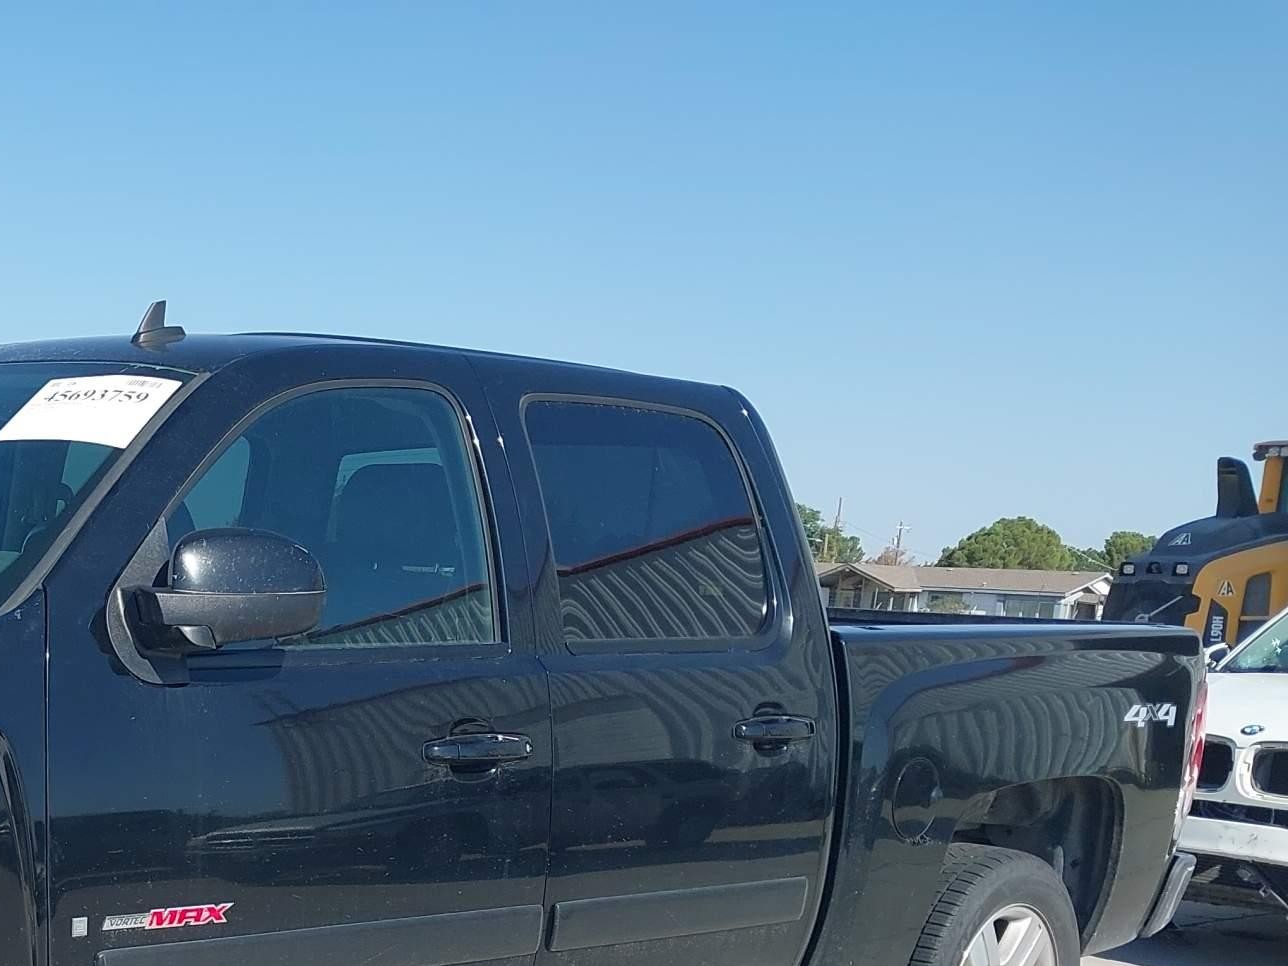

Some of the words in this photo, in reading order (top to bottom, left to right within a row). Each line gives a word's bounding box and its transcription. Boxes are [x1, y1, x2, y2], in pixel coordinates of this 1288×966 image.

[44, 389, 149, 403] 45693759
[1210, 616, 1224, 641] L90H
[146, 903, 234, 929] MAX
